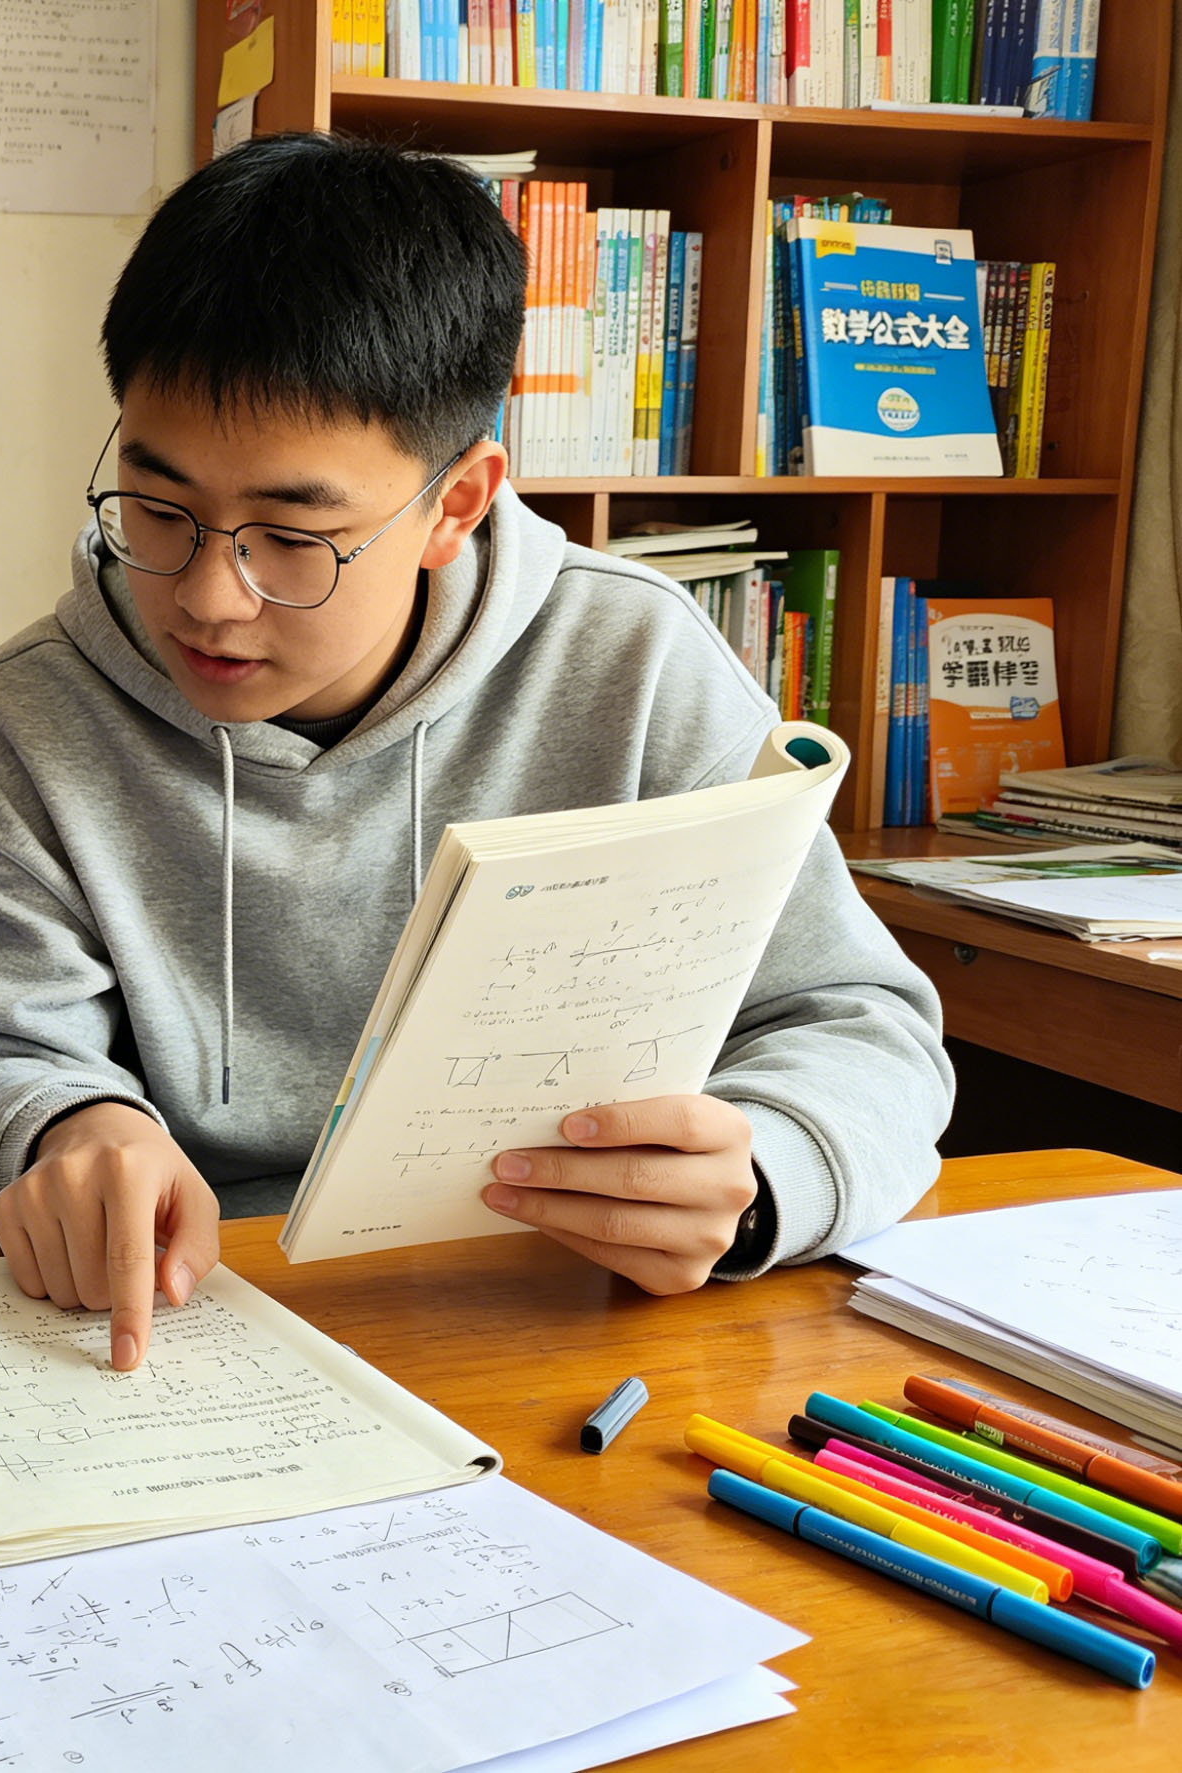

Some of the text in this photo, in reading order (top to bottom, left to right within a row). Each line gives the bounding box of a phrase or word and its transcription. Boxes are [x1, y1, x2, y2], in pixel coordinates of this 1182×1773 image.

[821, 307, 970, 349] 数学公式大全
